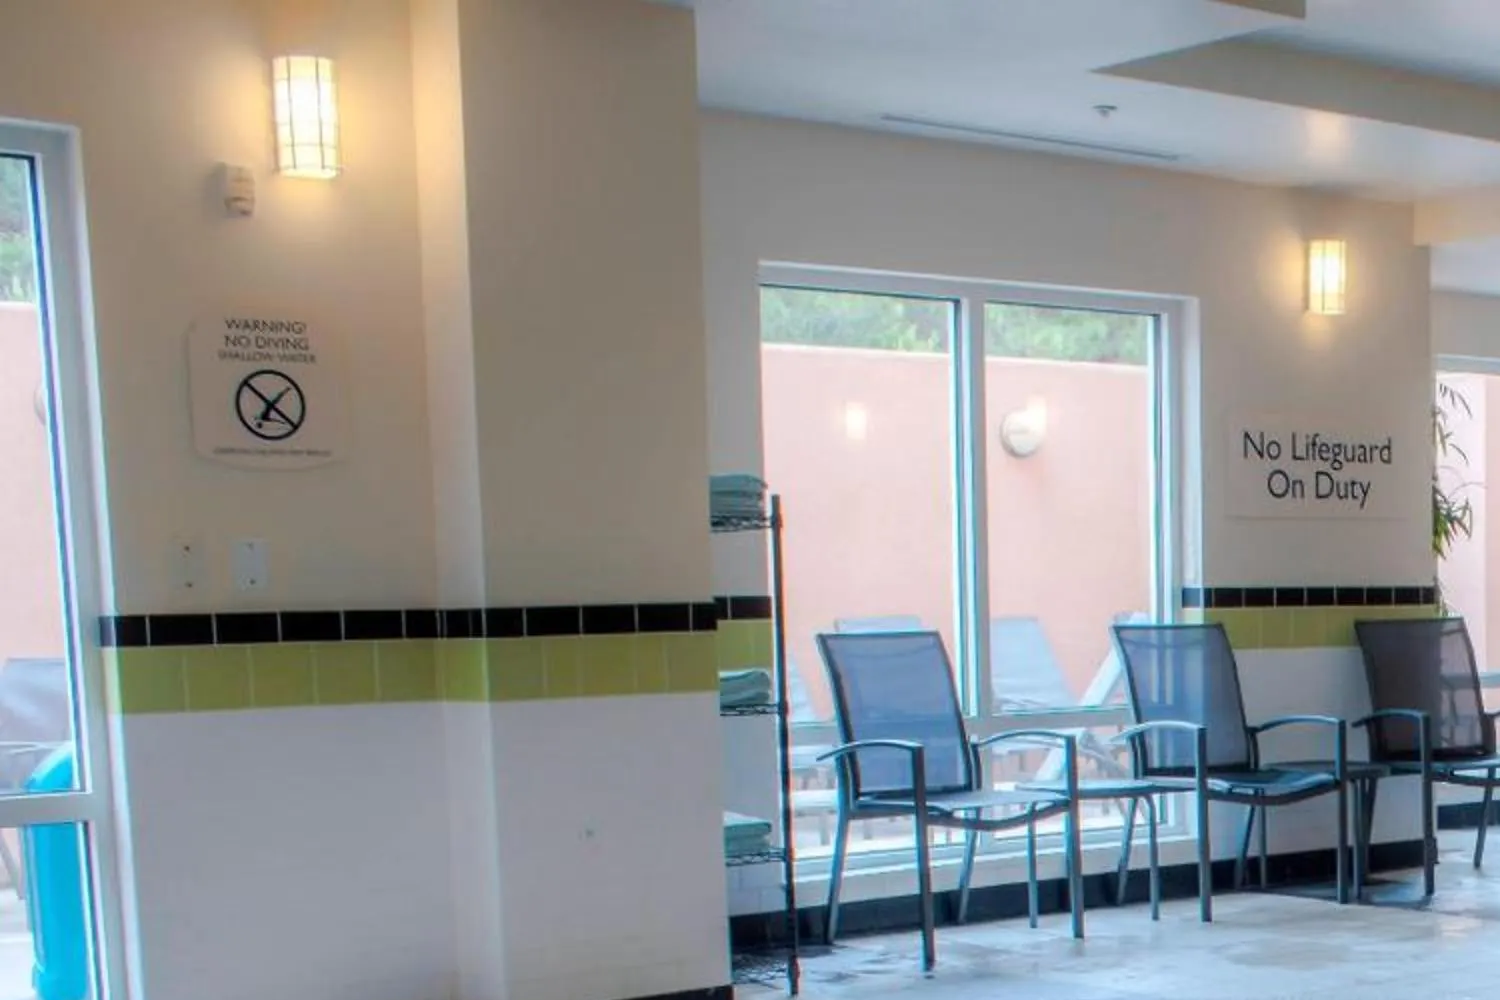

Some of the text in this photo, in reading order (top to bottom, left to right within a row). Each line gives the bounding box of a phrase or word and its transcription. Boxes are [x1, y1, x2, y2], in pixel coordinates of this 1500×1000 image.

[218, 351, 273, 363] SHALLOW
[224, 335, 309, 351] NO DIVING
[1242, 430, 1393, 472] No Lifeguard
[1266, 468, 1372, 510] On Duty
